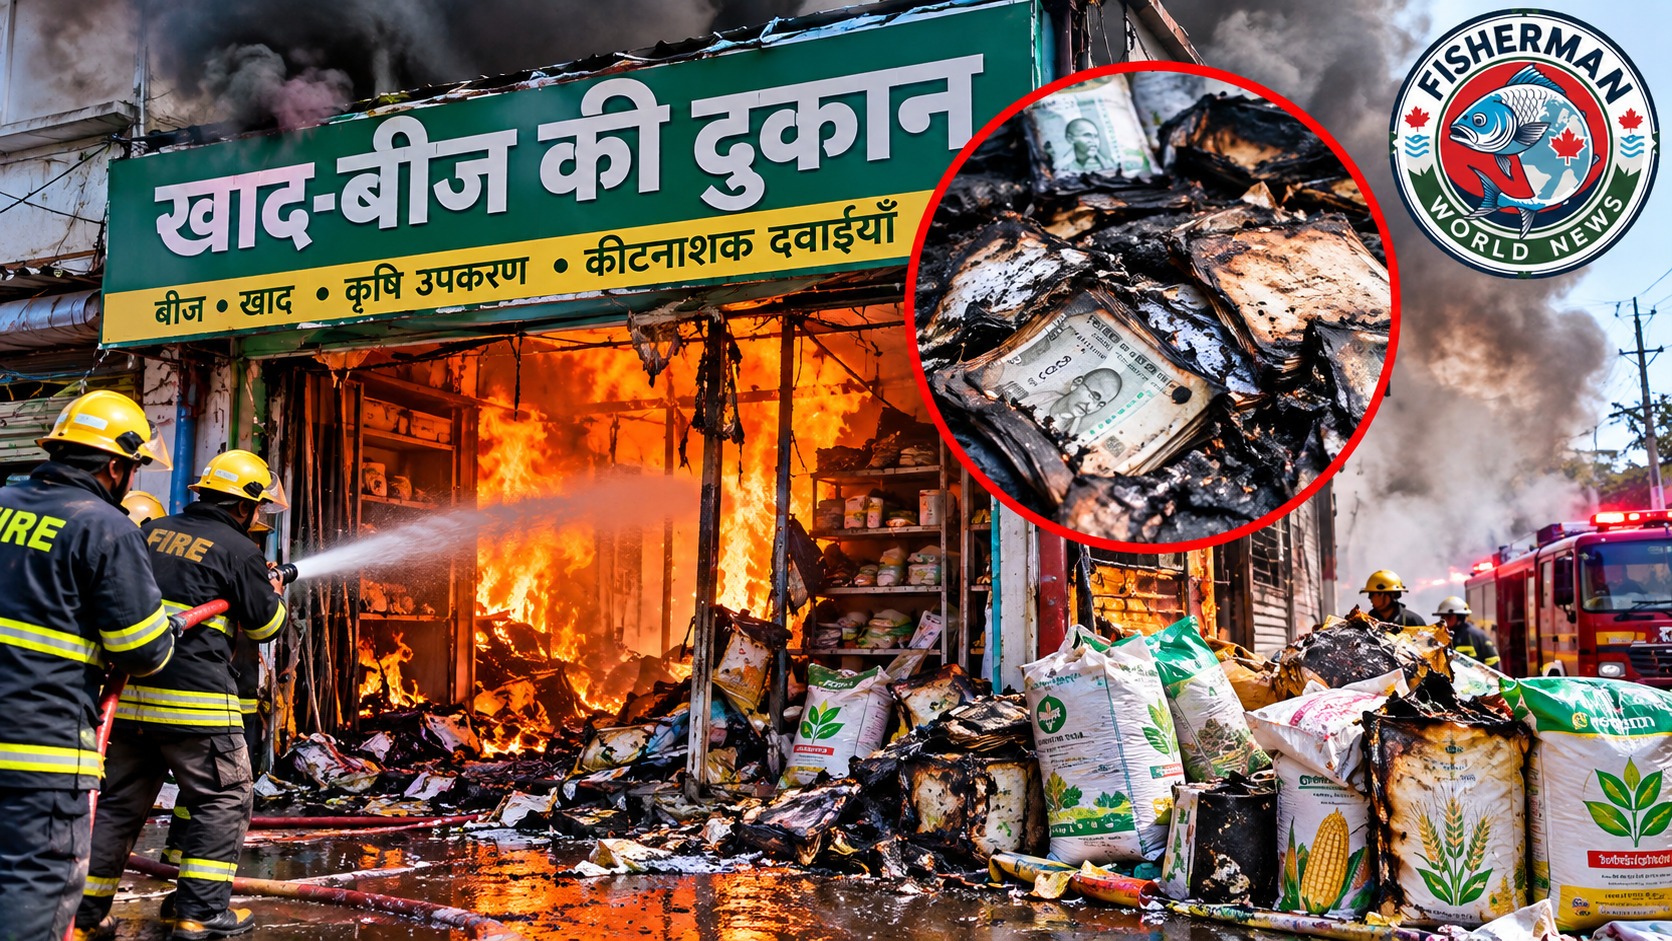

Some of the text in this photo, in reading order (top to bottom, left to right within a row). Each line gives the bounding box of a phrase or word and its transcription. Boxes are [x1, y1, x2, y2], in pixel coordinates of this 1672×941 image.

[154, 53, 984, 257] खाद-बीज की दुकान
[155, 199, 898, 326] बीज खाद कृषि उपकरण कीटनाशक दवाईयाँ
[0, 506, 67, 552] IRE
[146, 528, 215, 563] FIRE
